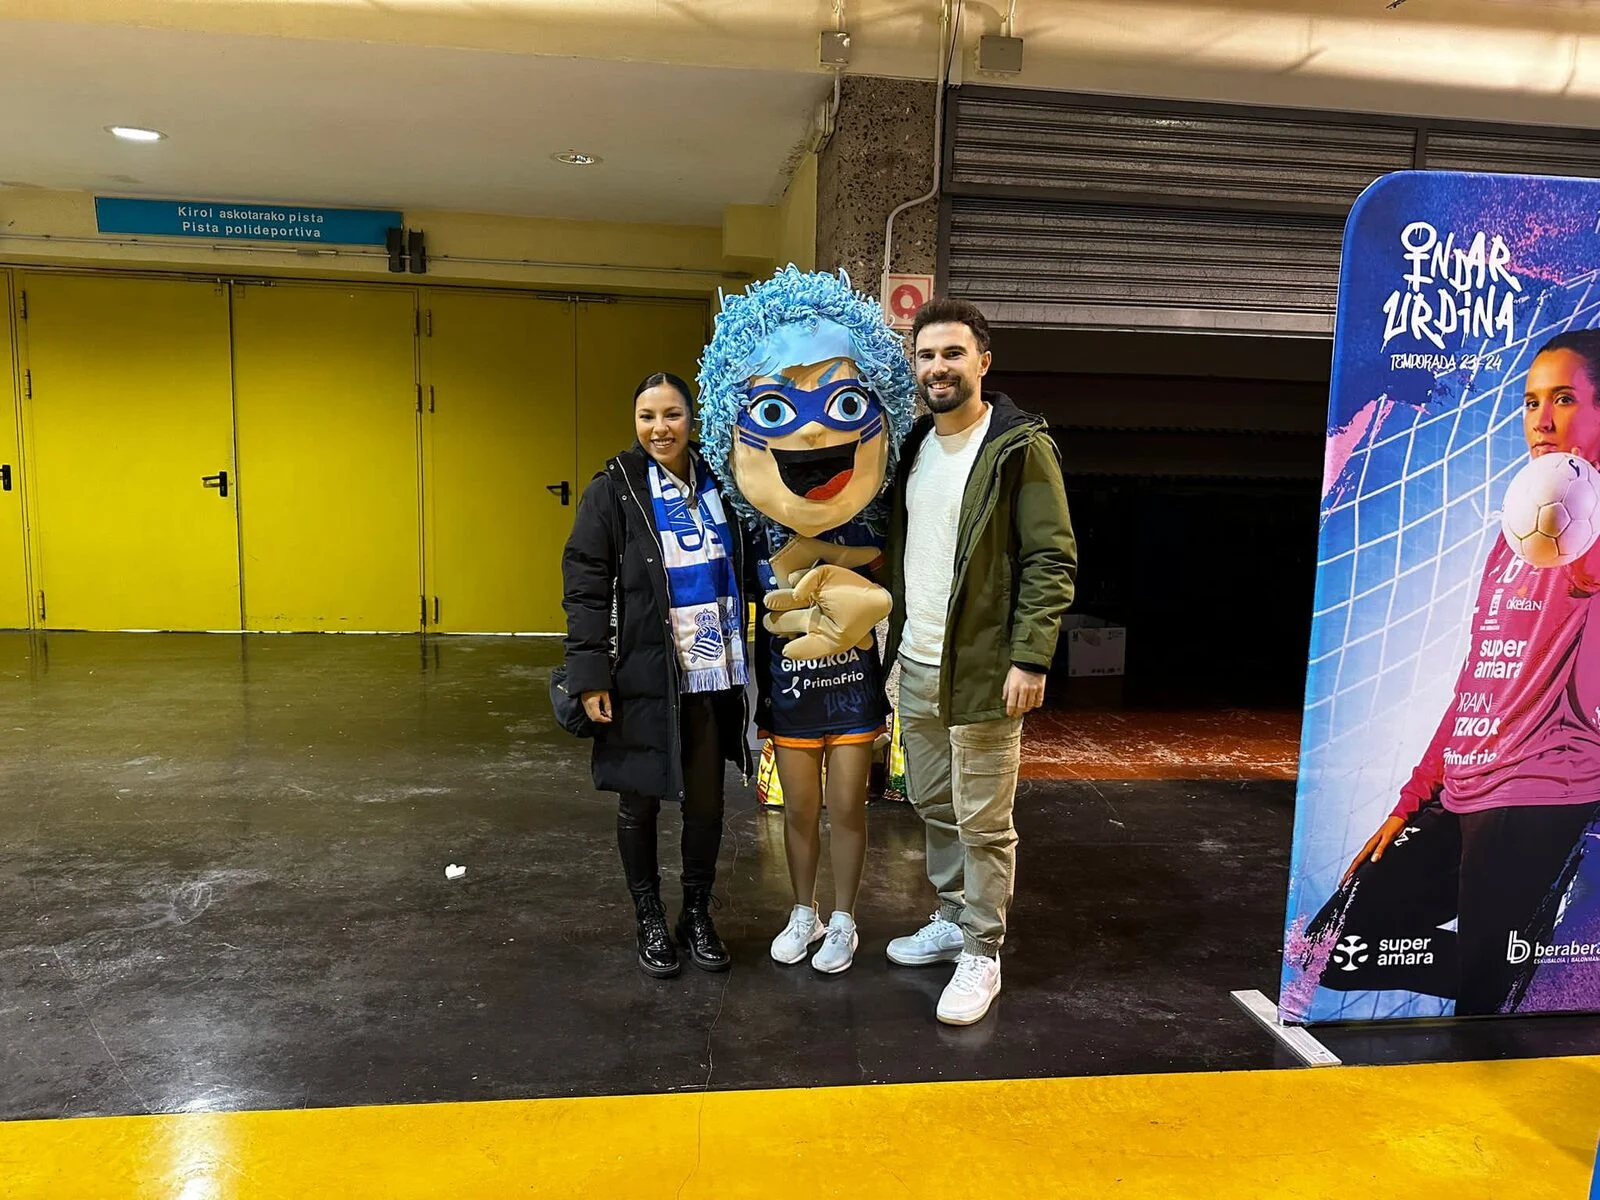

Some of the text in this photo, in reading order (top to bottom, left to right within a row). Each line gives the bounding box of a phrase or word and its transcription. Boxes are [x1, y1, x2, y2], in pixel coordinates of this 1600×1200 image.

[178, 206, 324, 225] Kirol askotarako pista
[182, 221, 321, 239] Pista polideportiva
[1390, 353, 1457, 372] TEMPORADA
[1479, 639, 1528, 660] super
[780, 648, 860, 672] GIPUZKOA
[1378, 937, 1432, 953] super
[1376, 950, 1434, 966] amara
